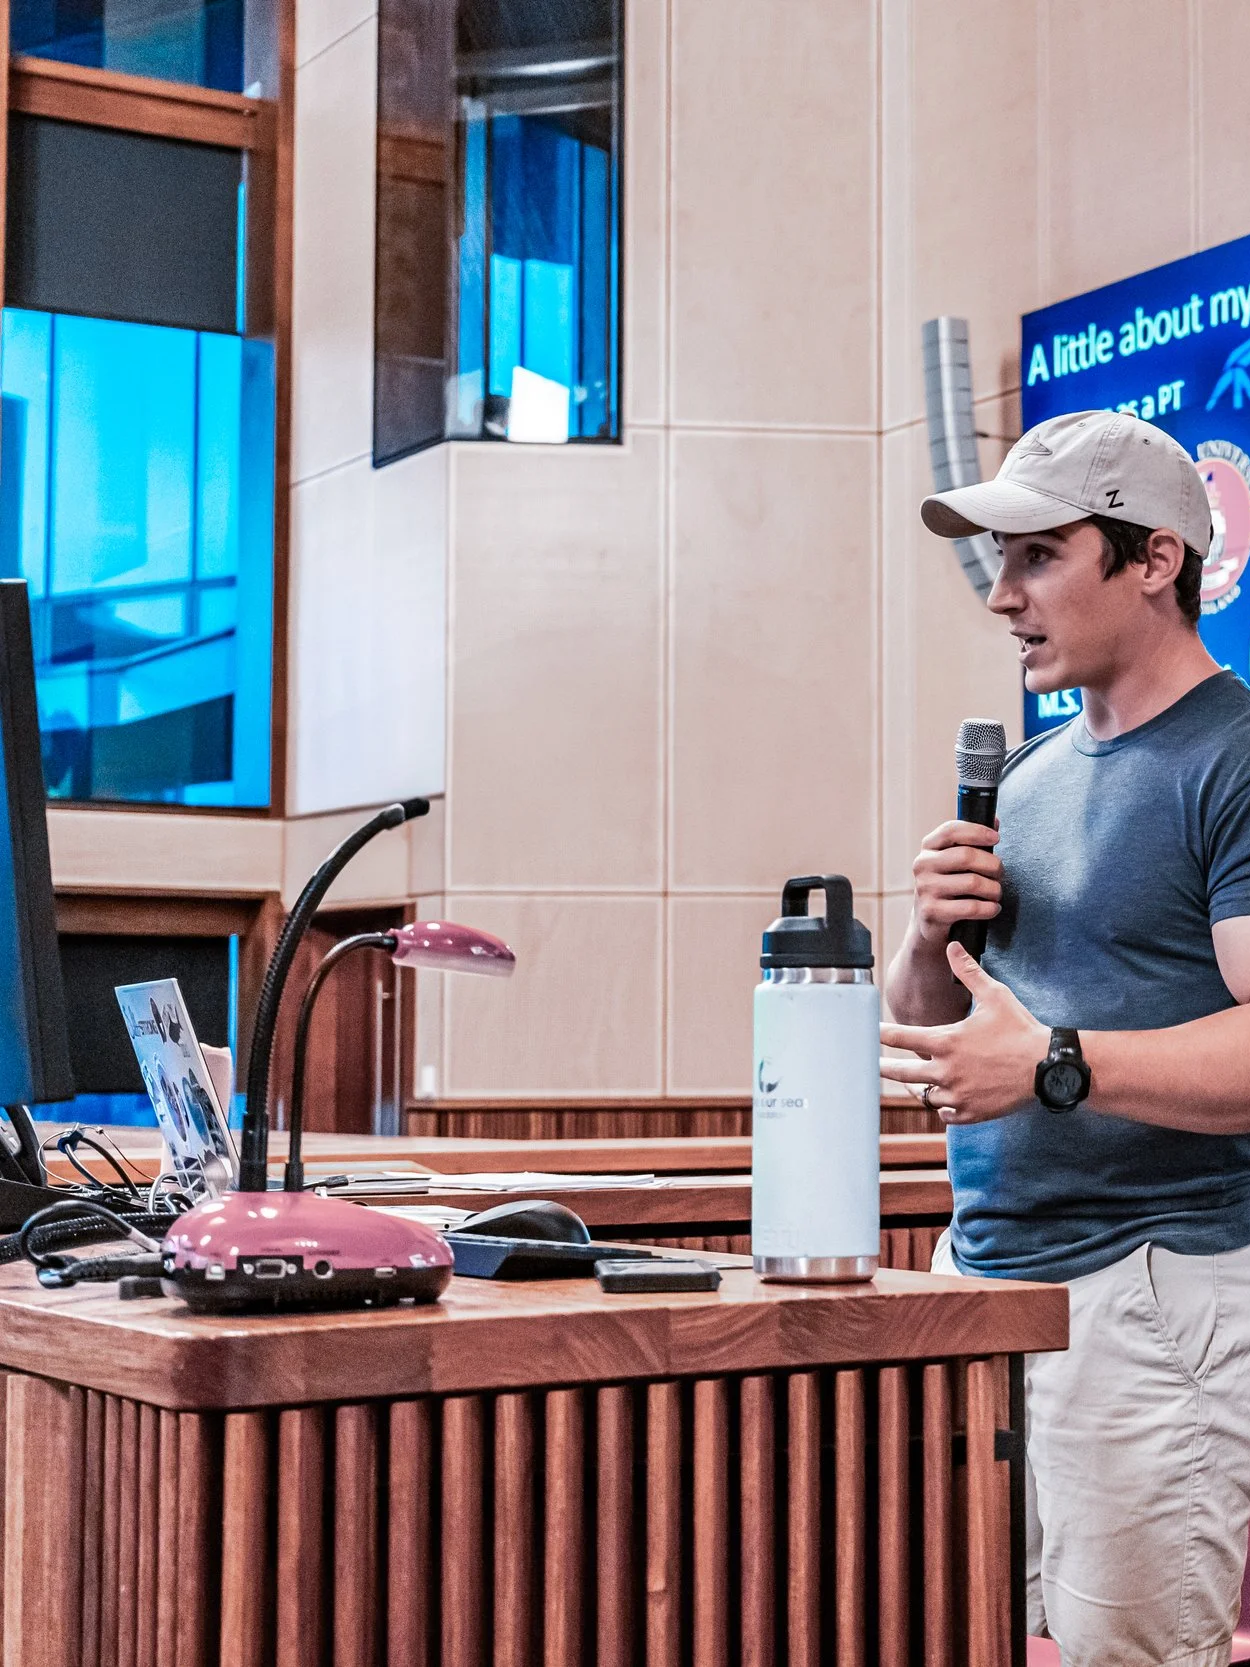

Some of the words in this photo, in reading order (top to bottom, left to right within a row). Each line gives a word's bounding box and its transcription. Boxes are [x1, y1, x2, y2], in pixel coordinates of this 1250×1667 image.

[1027, 343, 1050, 387] A
[1053, 322, 1114, 378] little
[1119, 293, 1205, 357] about
[1141, 394, 1156, 421] a
[1157, 379, 1186, 416] PT
[1037, 688, 1081, 719] M.S.
